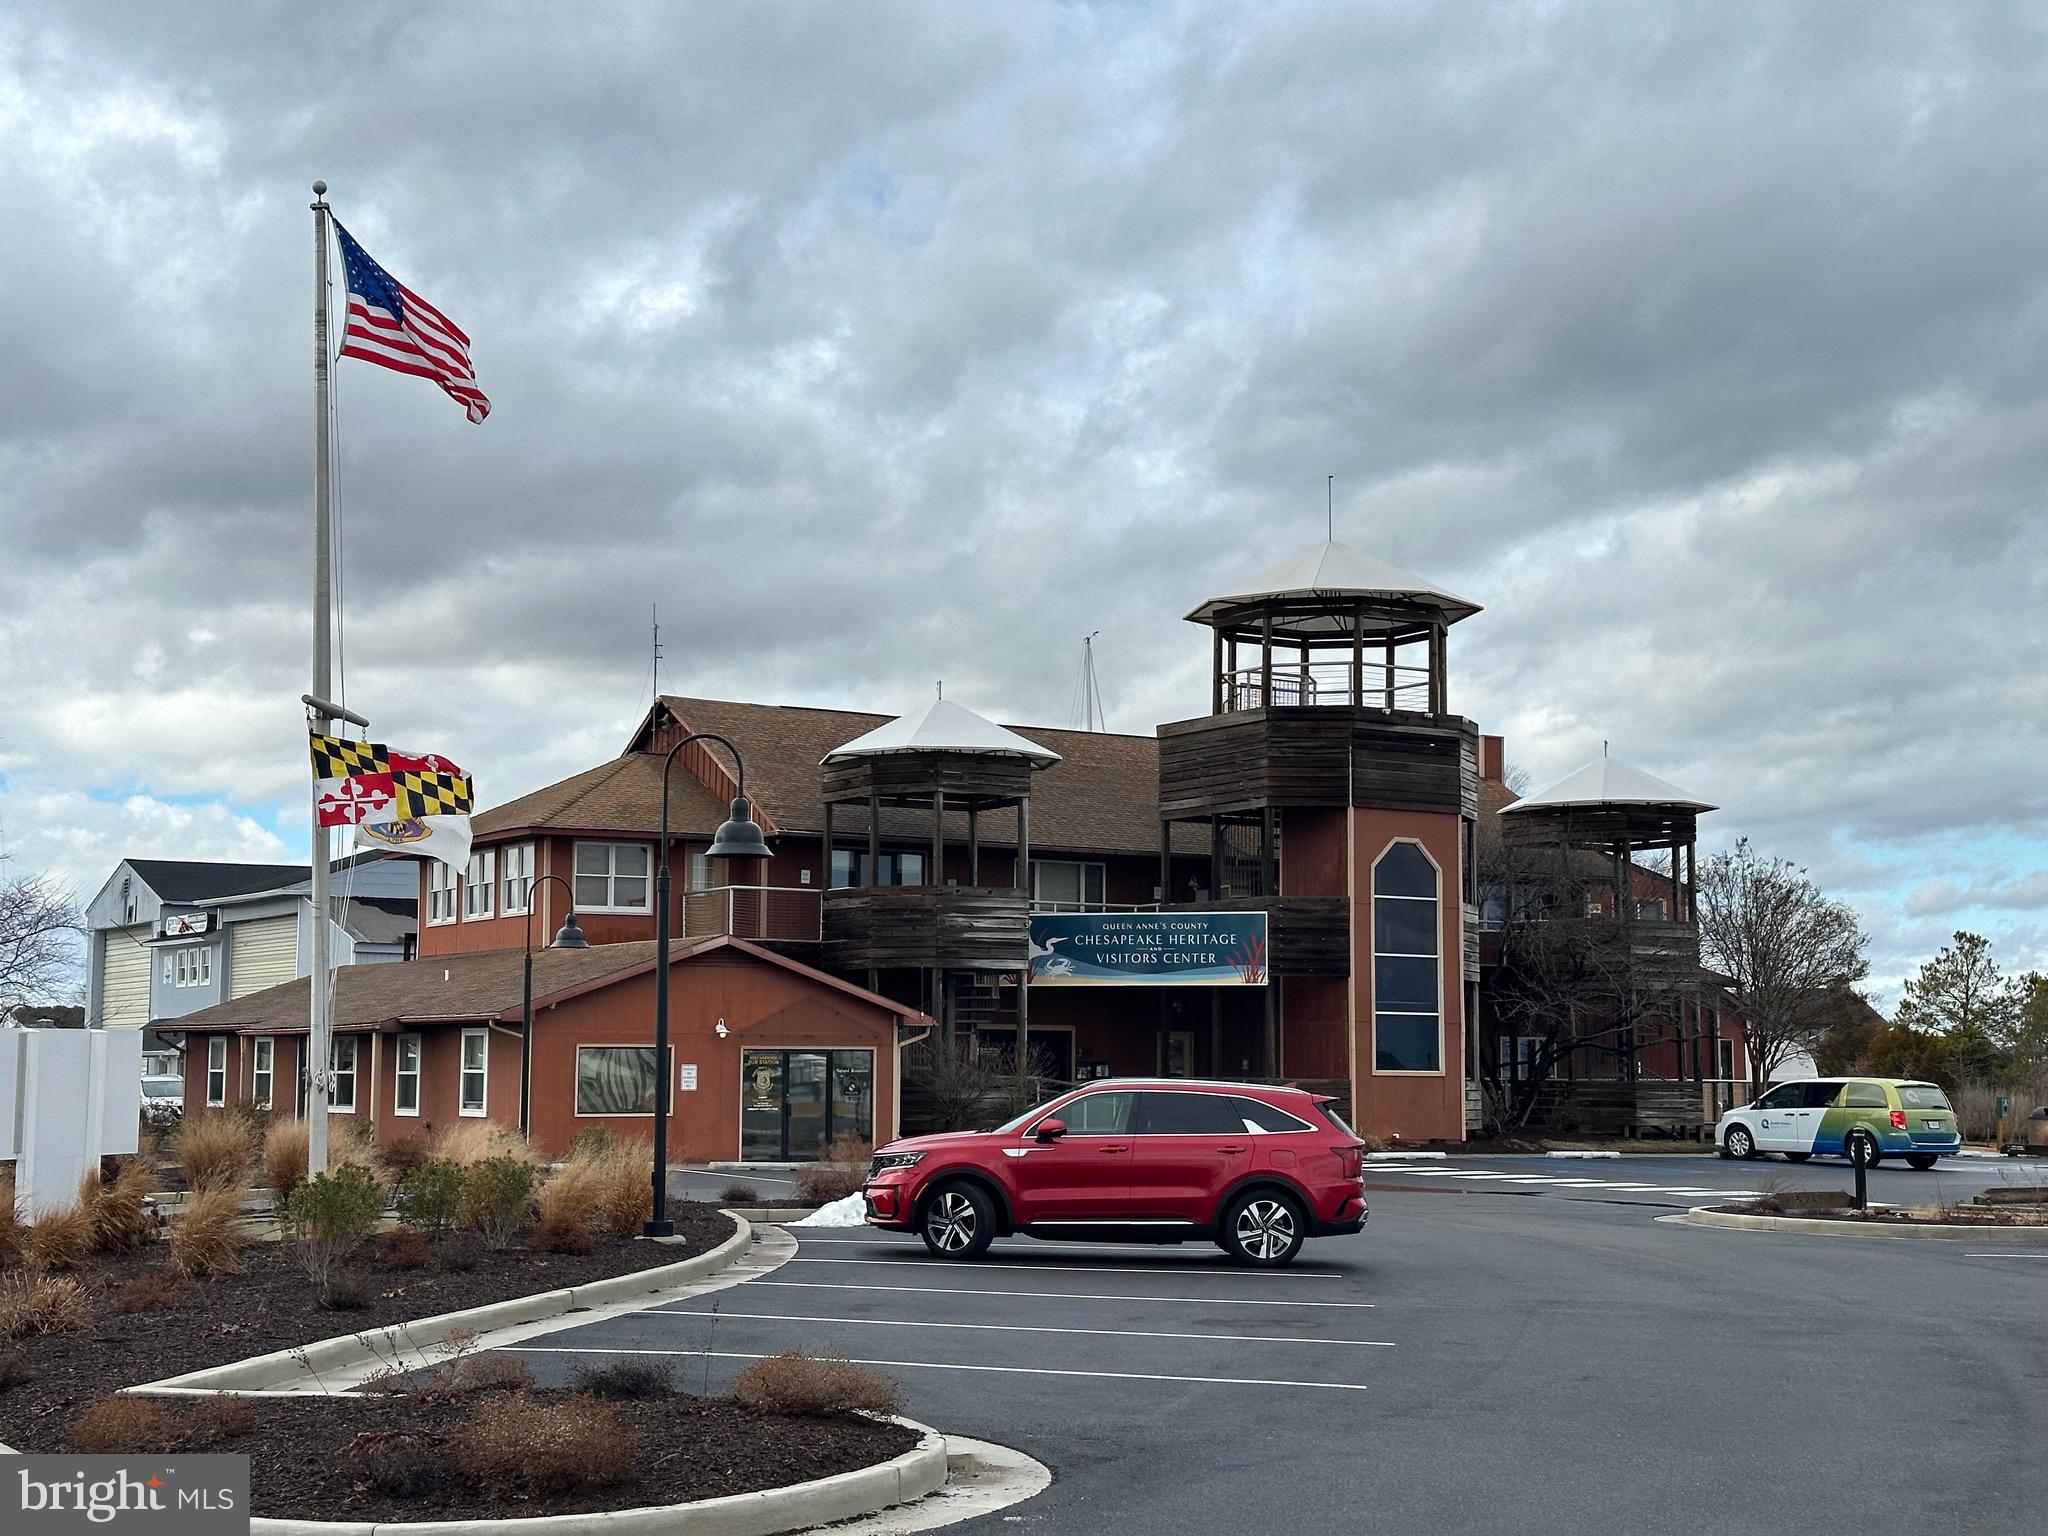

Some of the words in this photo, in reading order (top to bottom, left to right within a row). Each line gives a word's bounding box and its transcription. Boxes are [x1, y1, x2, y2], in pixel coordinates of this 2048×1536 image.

[1102, 922, 1133, 930] QUEEN
[1136, 922, 1167, 930] ANNE'S
[1170, 922, 1209, 930] COUNTY
[1075, 934, 1163, 946] CHESAPEAKE
[1169, 933, 1237, 945] HERITAGE
[1096, 953, 1158, 964] VISITORS
[1163, 953, 1216, 964] CENTER
